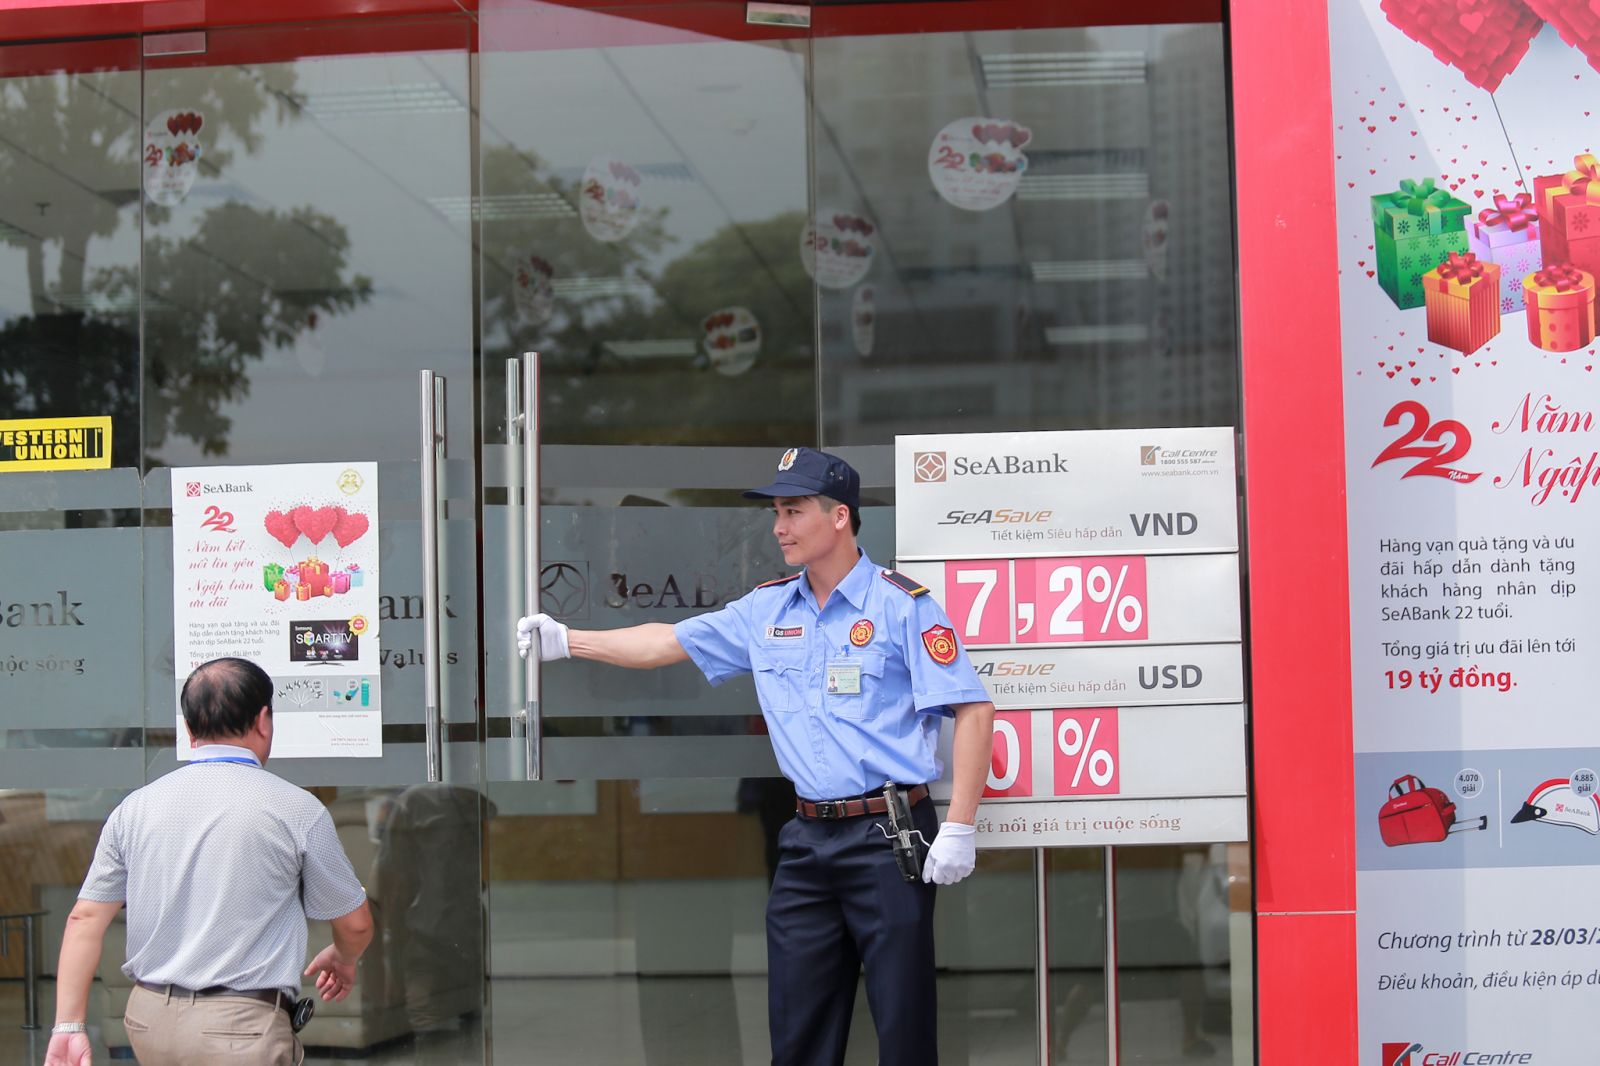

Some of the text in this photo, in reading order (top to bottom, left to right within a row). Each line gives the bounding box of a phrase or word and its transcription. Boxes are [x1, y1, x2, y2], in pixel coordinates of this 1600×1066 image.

[1491, 392, 1595, 435] Năm
[0, 428, 83, 446] ESTERN
[1370, 400, 1483, 484] 22
[15, 444, 83, 460] UNION
[1161, 448, 1218, 458] Call Centre
[954, 453, 1069, 476] SeABank
[1141, 468, 1219, 478] www.seabank.com.vn
[203, 482, 253, 494] SeABank
[200, 505, 237, 533] 22
[938, 509, 1053, 525] SeASave
[1130, 512, 1198, 536] VND
[991, 529, 1013, 541] Tiết
[1016, 530, 1044, 542] kiệm
[1047, 528, 1072, 539] Siêu
[1075, 527, 1097, 540] hấp
[1380, 535, 1574, 556] Hàng vạn quà tặng và ưu
[1380, 558, 1575, 578] đãi hấp dẫn dành tặng
[1381, 580, 1576, 600] khách hàng nhân dịp
[0, 590, 85, 628] ank
[956, 565, 1143, 637] 7,2%
[1381, 602, 1513, 621] SeABank 22 tuổi.
[296, 631, 338, 646] SART
[380, 648, 458, 668] Vals
[1381, 638, 1576, 660] Tổng giá trị ưu đãi lên tới
[973, 662, 1056, 677] ASave
[1138, 664, 1203, 689] USD
[1384, 664, 1518, 694] 19 tỷ đồng.
[993, 683, 1015, 694] Tiết
[1017, 682, 1047, 696] kiệm
[1050, 682, 1075, 693] Siêu
[1078, 681, 1100, 694] hấp
[1459, 774, 1479, 783] 4.070
[1574, 774, 1594, 782] 4.885
[1462, 784, 1476, 794] giải
[1578, 783, 1592, 794] giải
[976, 813, 1181, 834] ết nối giá trị cuộc sống
[1378, 932, 1452, 953] Chương
[1457, 929, 1501, 948] trình
[1507, 929, 1528, 947] từ
[1378, 972, 1416, 991] Điều
[1421, 973, 1478, 990] khoản,
[1482, 971, 1518, 988] điều
[1522, 971, 1556, 990] kiện
[1561, 970, 1582, 990] áp
[1422, 1050, 1532, 1066] Call Centre
